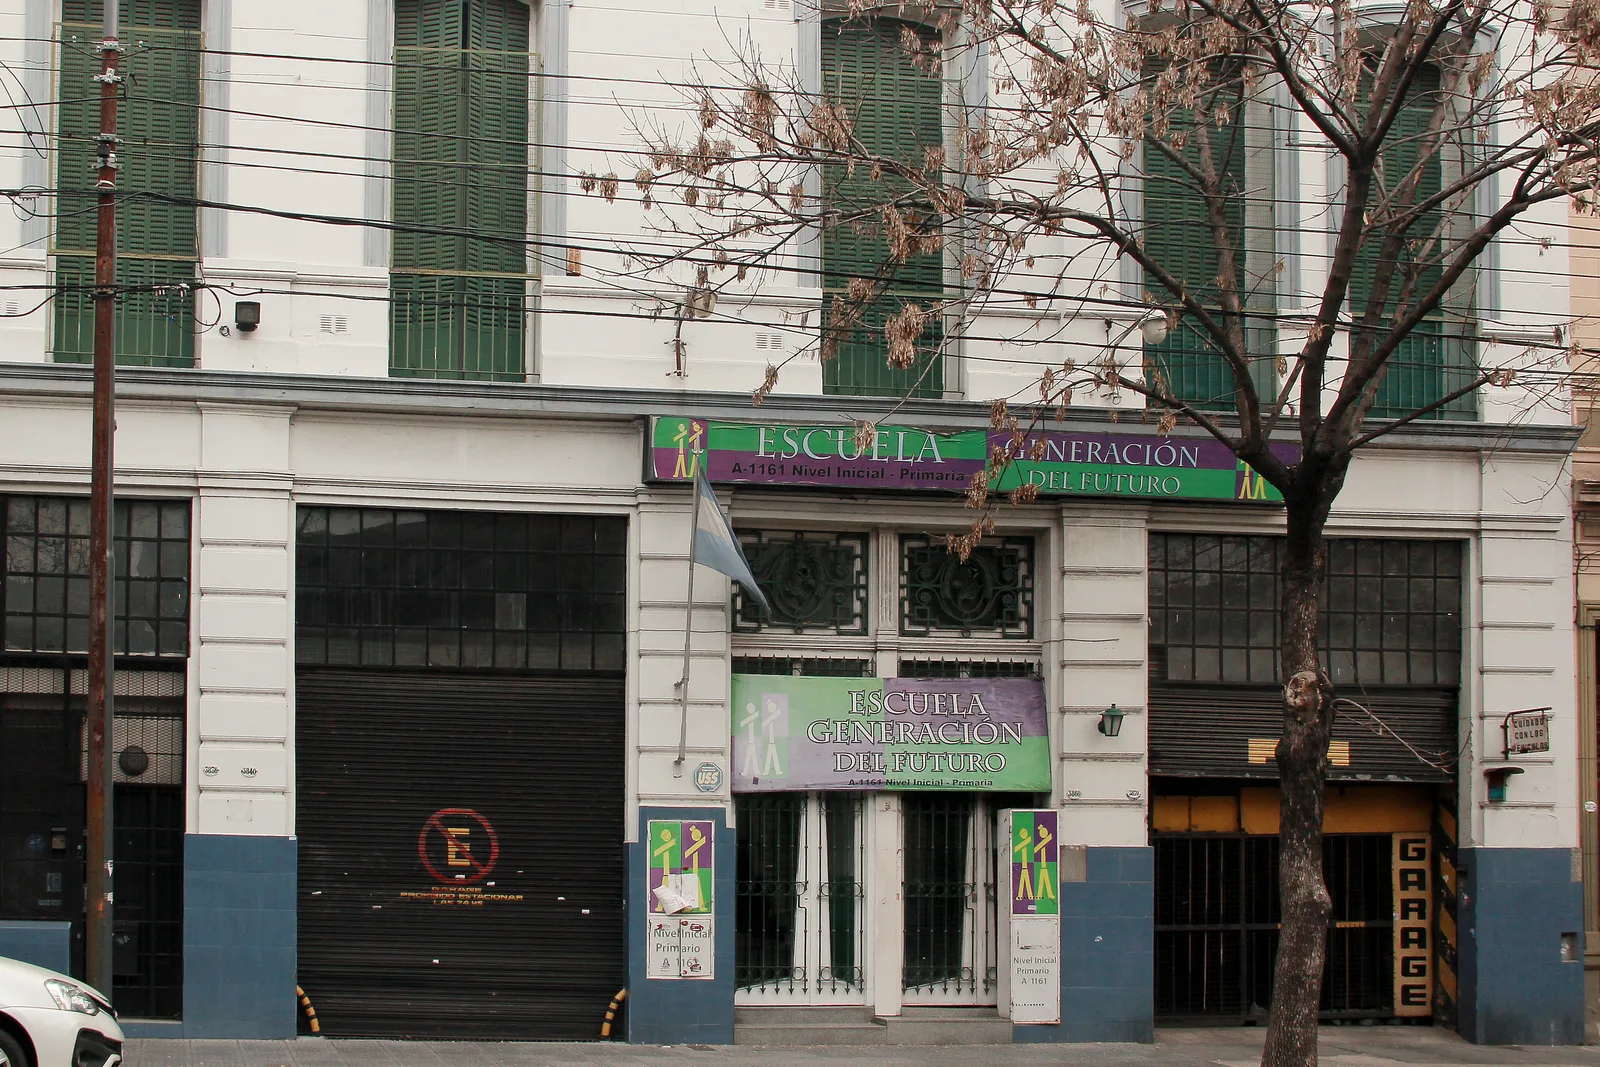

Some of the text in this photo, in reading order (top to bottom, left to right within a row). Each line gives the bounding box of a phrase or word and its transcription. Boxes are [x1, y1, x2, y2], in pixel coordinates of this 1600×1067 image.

[755, 427, 945, 466] ESCUELA
[732, 463, 785, 475] A-1161
[792, 465, 831, 478] Nivel
[836, 467, 884, 479] Inicial
[900, 468, 965, 482] Primaria
[1027, 470, 1181, 495] DEL FUTURO
[848, 690, 990, 716] ESCUELA
[806, 716, 1023, 746] GENERACIÓN
[1514, 718, 1544, 728] CUIDADO
[833, 752, 1007, 774] DEL FUTURO
[698, 772, 719, 784] USS
[952, 779, 993, 787] Primaria
[447, 828, 471, 866] E
[1399, 838, 1427, 1006] GARAGE
[653, 929, 711, 938] Nivel Inicial
[656, 943, 700, 953] Primario
[662, 957, 670, 967] A
[1016, 967, 1050, 975] Primario
